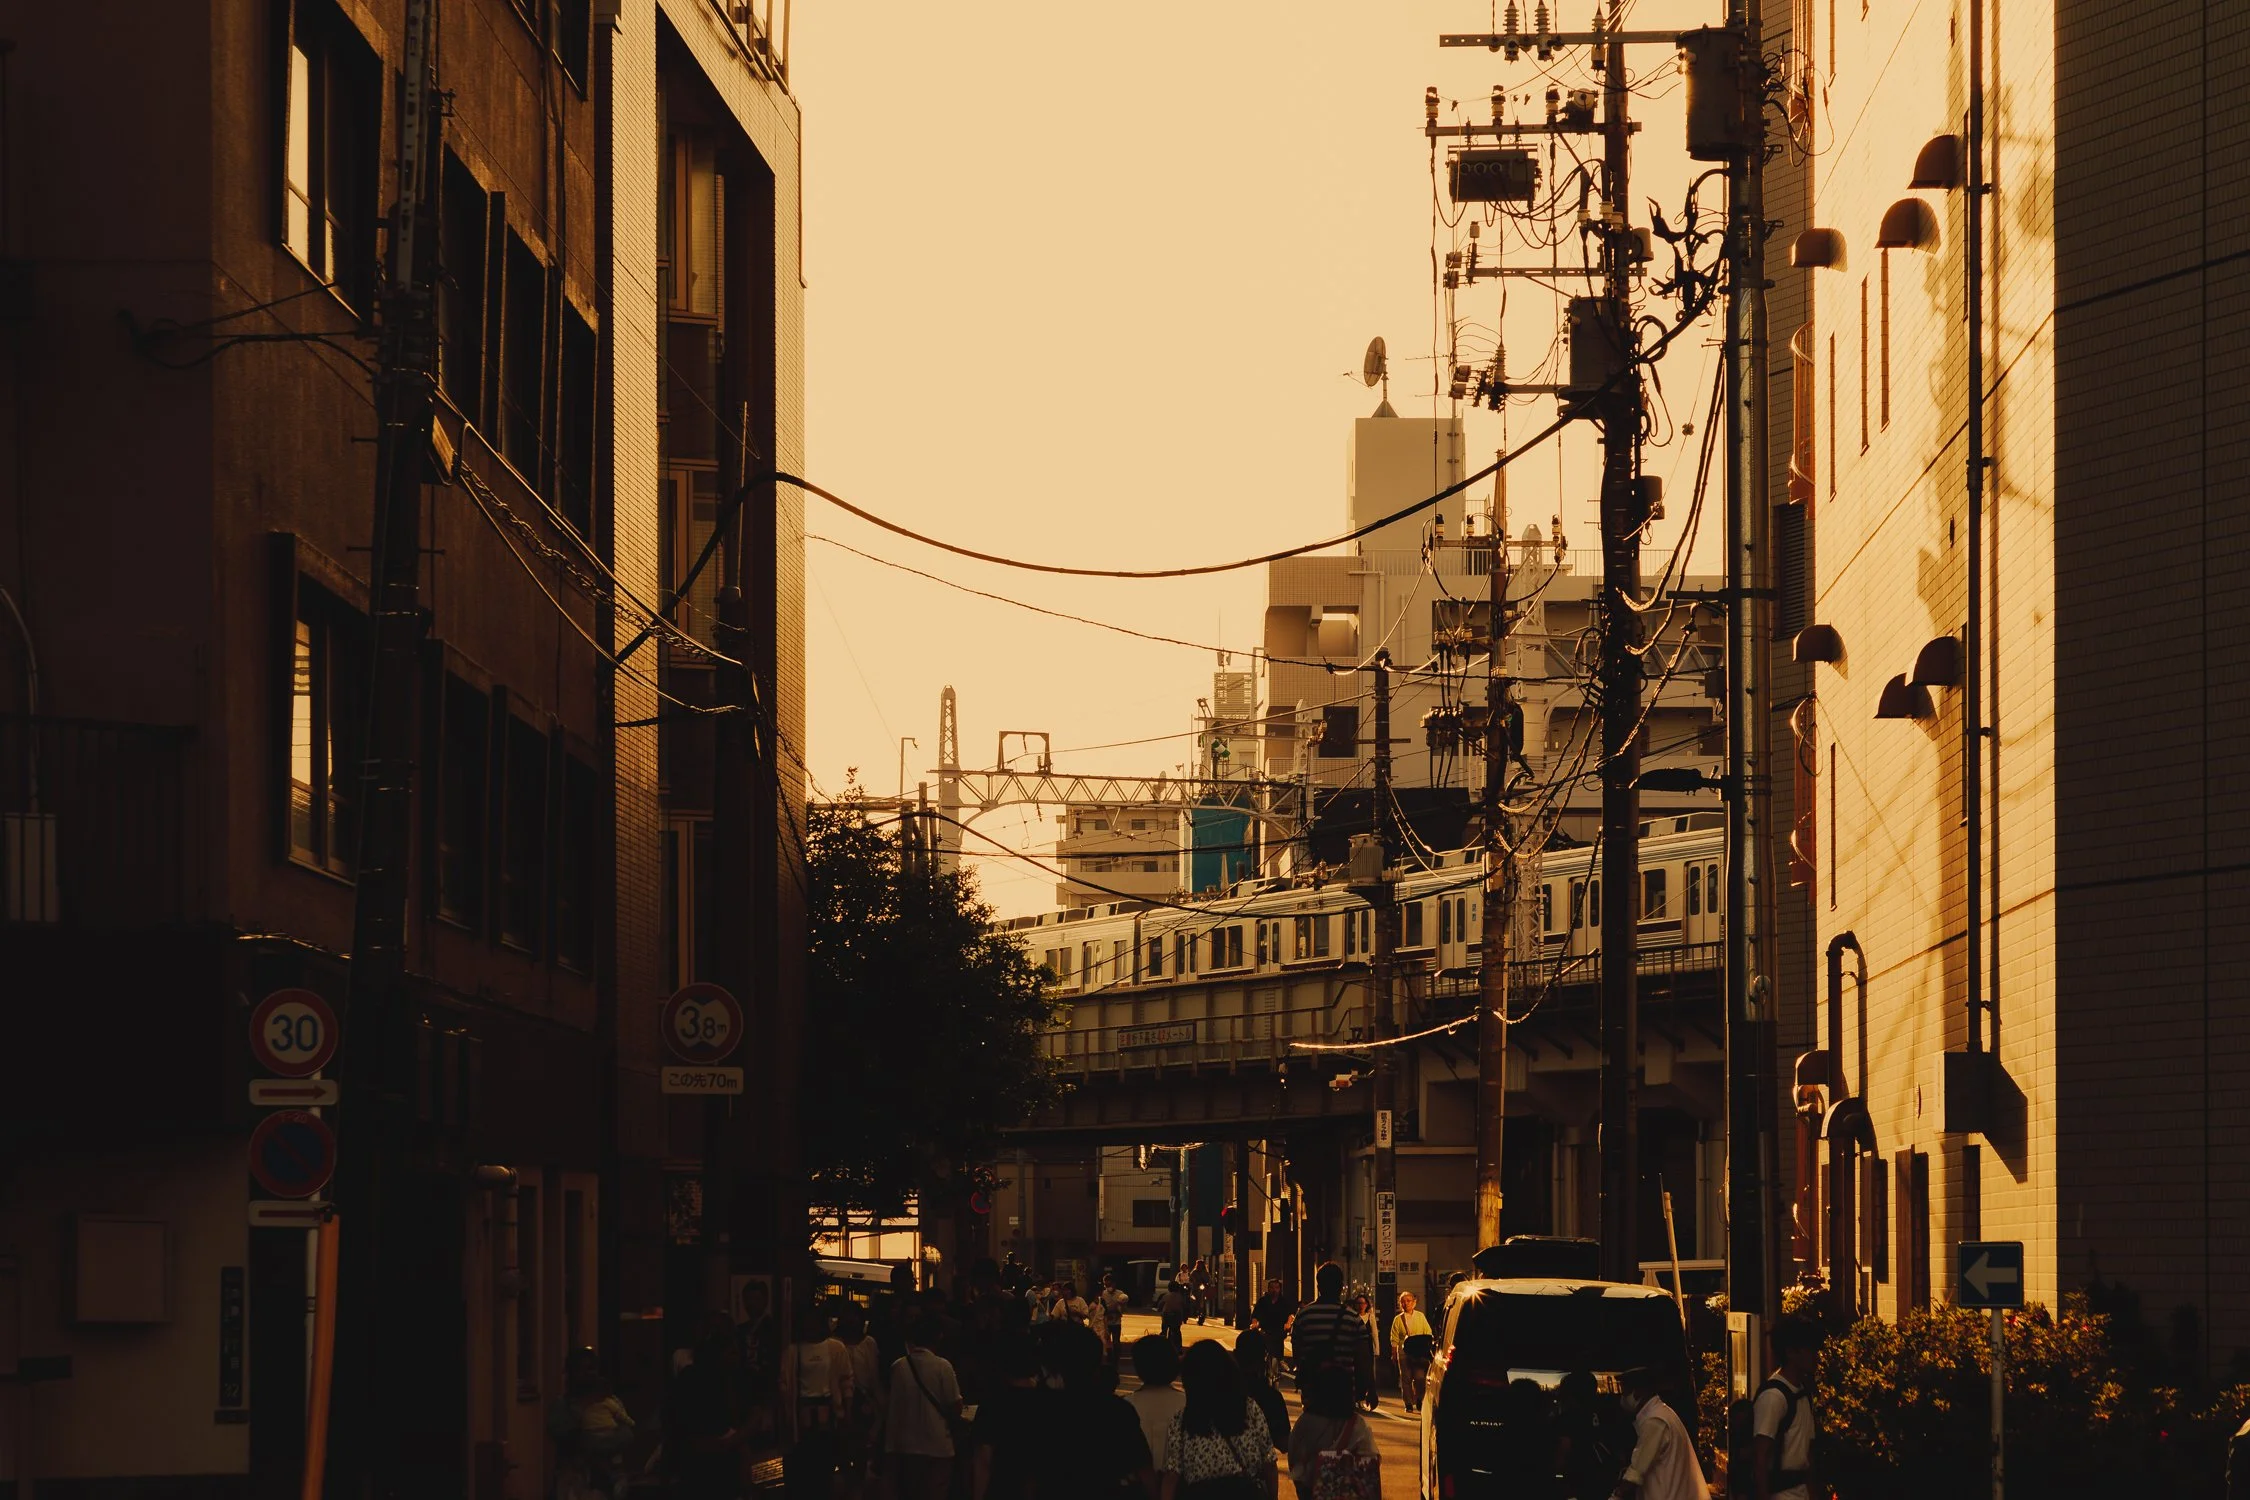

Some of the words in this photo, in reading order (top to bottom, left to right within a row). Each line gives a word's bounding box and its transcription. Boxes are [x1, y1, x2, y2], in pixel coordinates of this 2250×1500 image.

[271, 1014, 318, 1052] 30
[668, 1072, 737, 1089] この先70m
